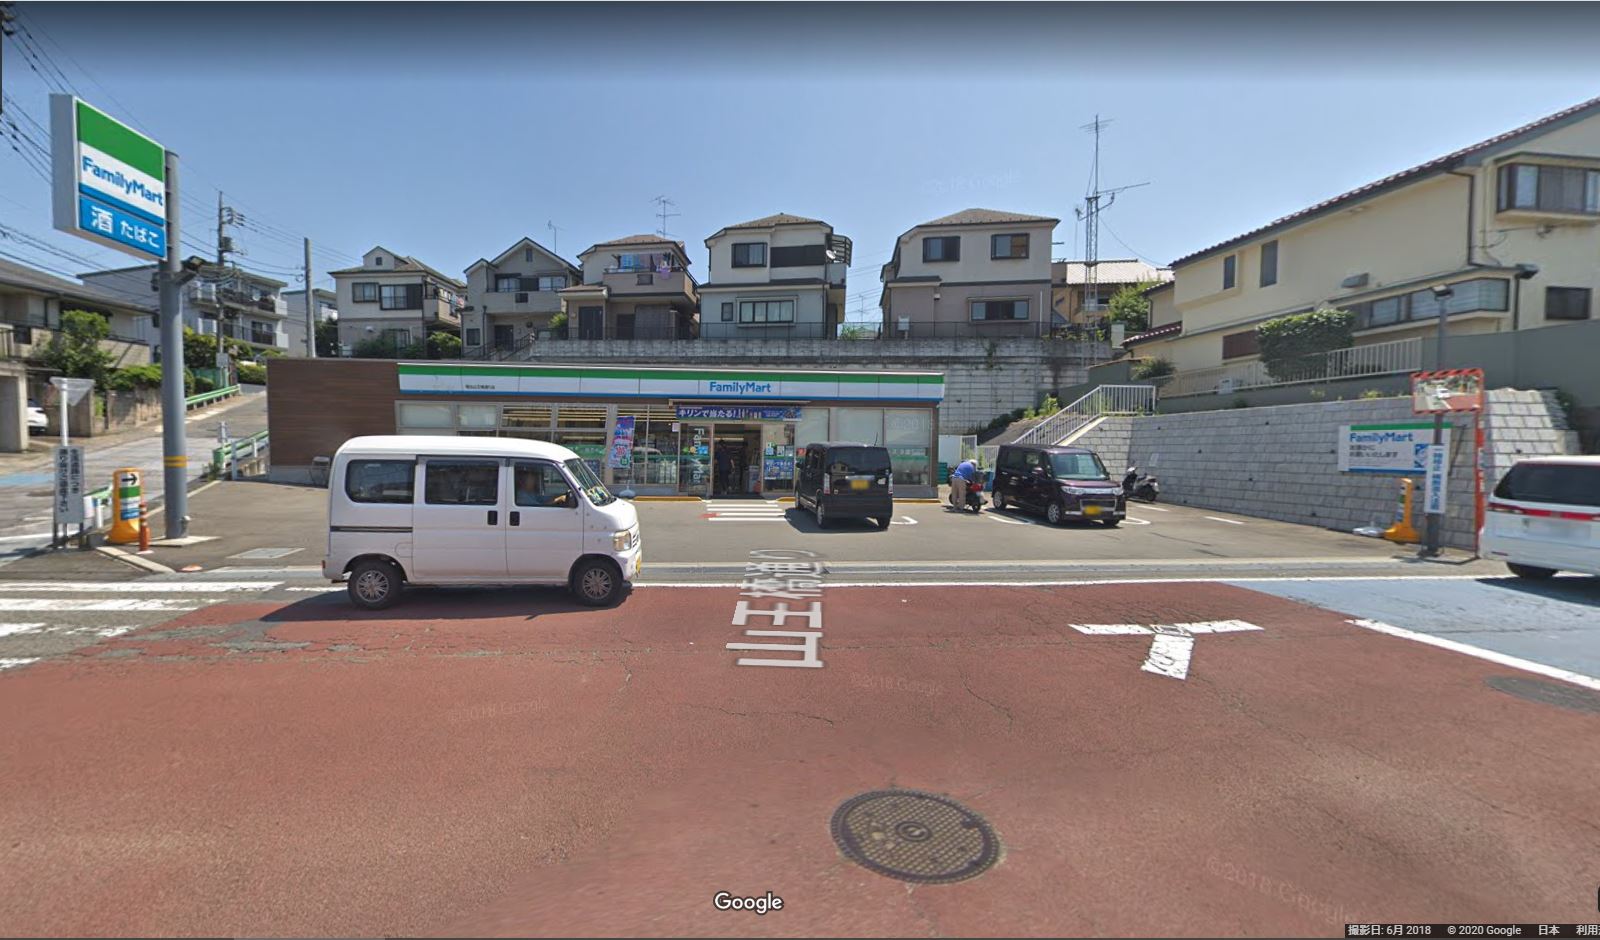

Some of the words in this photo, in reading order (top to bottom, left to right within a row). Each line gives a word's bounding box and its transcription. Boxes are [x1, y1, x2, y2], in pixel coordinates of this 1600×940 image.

[82, 155, 163, 206] FamilyMart
[91, 206, 113, 234] 酒
[120, 220, 160, 248] たばこ
[709, 381, 771, 394] FamilyMart
[1350, 432, 1413, 444] FamilyMart
